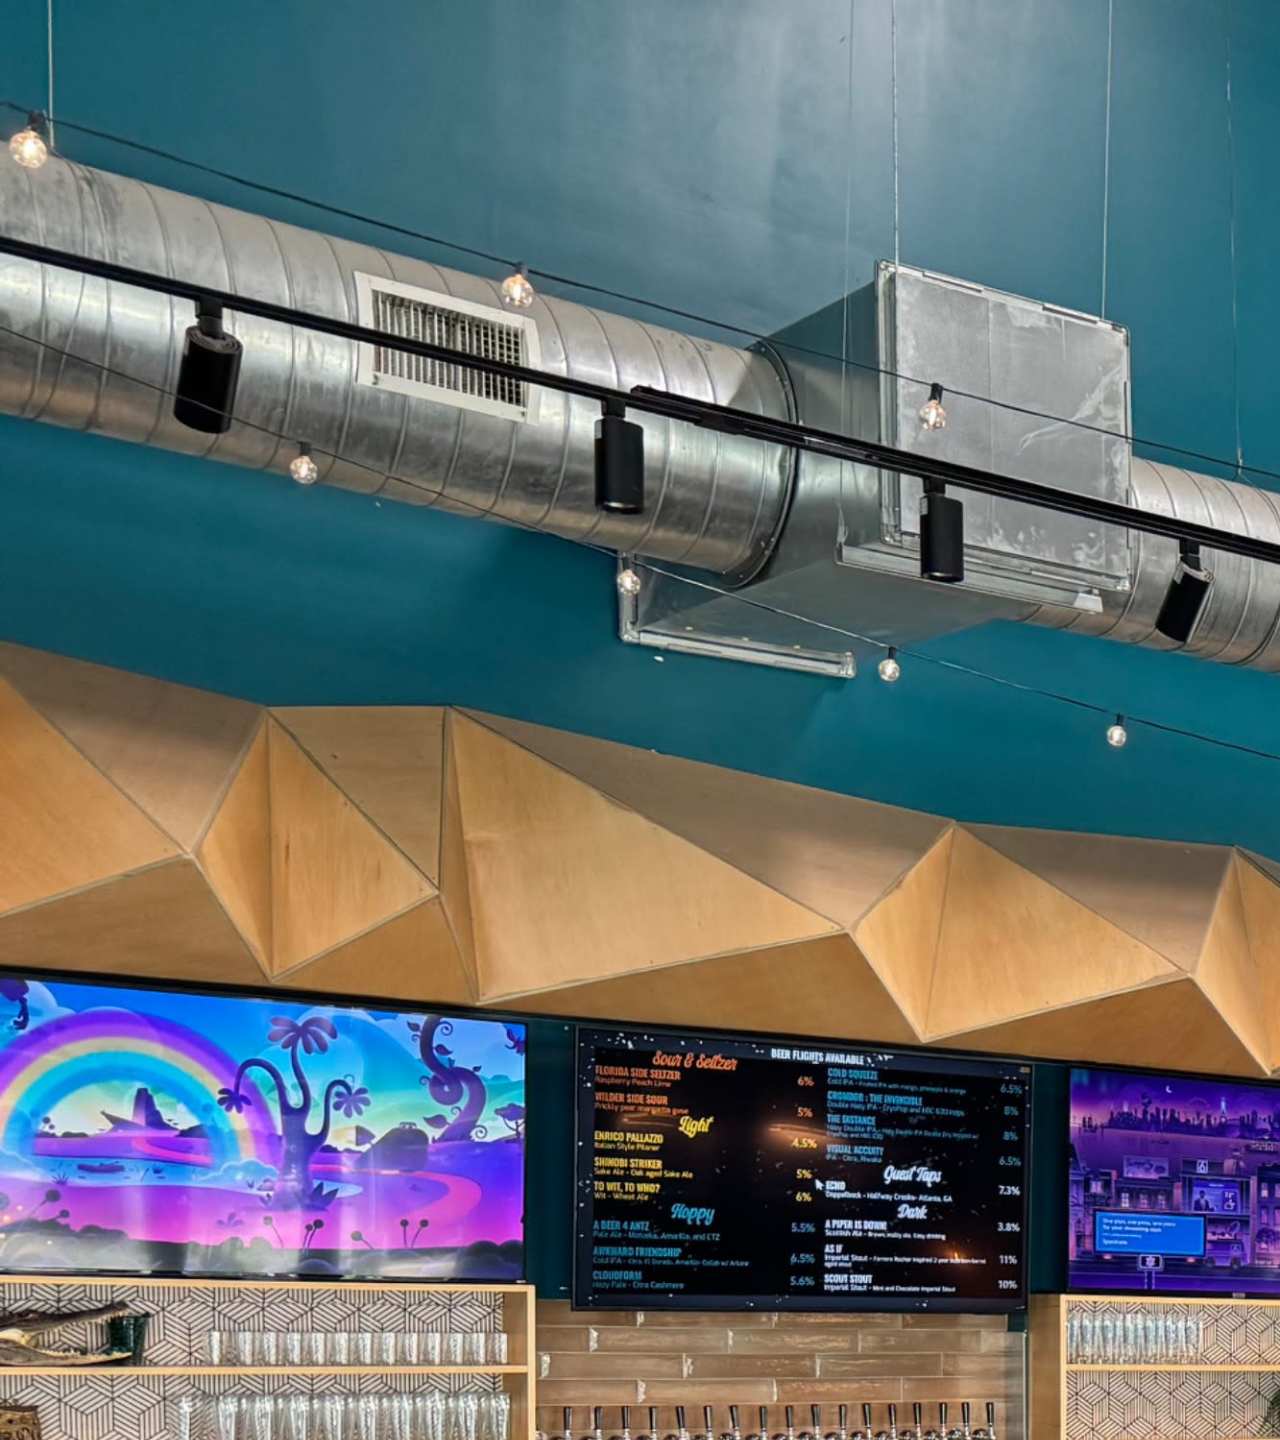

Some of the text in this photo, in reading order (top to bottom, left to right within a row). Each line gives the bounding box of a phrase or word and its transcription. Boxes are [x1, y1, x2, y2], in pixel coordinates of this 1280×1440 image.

[653, 1050, 738, 1070] Sour & Seltzer
[771, 1048, 864, 1065] BEER FLIGHTS AVAILABLE
[595, 1066, 681, 1080] FLORIDA SIDE SELTZER
[828, 1068, 878, 1079] COLD SQUEEZE
[798, 1076, 814, 1086] 6%
[1000, 1085, 1022, 1094] 6.5%
[595, 1092, 668, 1105] WILDER SIDE SOUR
[870, 1093, 882, 1103] THE
[798, 1107, 813, 1117] 5%
[1004, 1106, 1018, 1116] 8%
[828, 1114, 876, 1125] THE DISTANCE
[678, 1116, 714, 1140] Light
[594, 1131, 663, 1143] ENRICO PALLAZZO
[1003, 1132, 1018, 1141] 8%
[790, 1138, 817, 1148] 4.5%
[827, 1144, 855, 1154] VISUAL
[594, 1157, 663, 1169] SHINOBI STRIKER
[999, 1156, 1021, 1166] 6.5%
[797, 1169, 812, 1179] 5%
[884, 1165, 941, 1187] Guest Taps
[594, 1182, 660, 1194] TO WIT, TO WHO?
[825, 1181, 845, 1190] ECHO
[998, 1185, 1020, 1196] 7.3%
[796, 1192, 812, 1202] 6%
[867, 1192, 893, 1201] Halfway
[671, 1203, 715, 1225] Hoppy
[898, 1205, 928, 1219] Dark
[593, 1221, 649, 1231] A BEER 4 ANTZ
[792, 1223, 815, 1233] 5.5%
[825, 1220, 830, 1229] A
[832, 1220, 851, 1229] PIPER
[855, 1221, 862, 1230] IS
[998, 1223, 1020, 1232] 3.8%
[593, 1247, 681, 1257] AWKWARD FRIENDSHIP
[825, 1245, 843, 1253] AS IF
[790, 1254, 815, 1264] 6.5%
[1000, 1255, 1017, 1264] 11%
[593, 1270, 642, 1281] CLOUDFORM
[825, 1274, 872, 1284] SCOUT STOUT
[790, 1277, 815, 1286] 5.6%
[999, 1280, 1017, 1290] 10%
